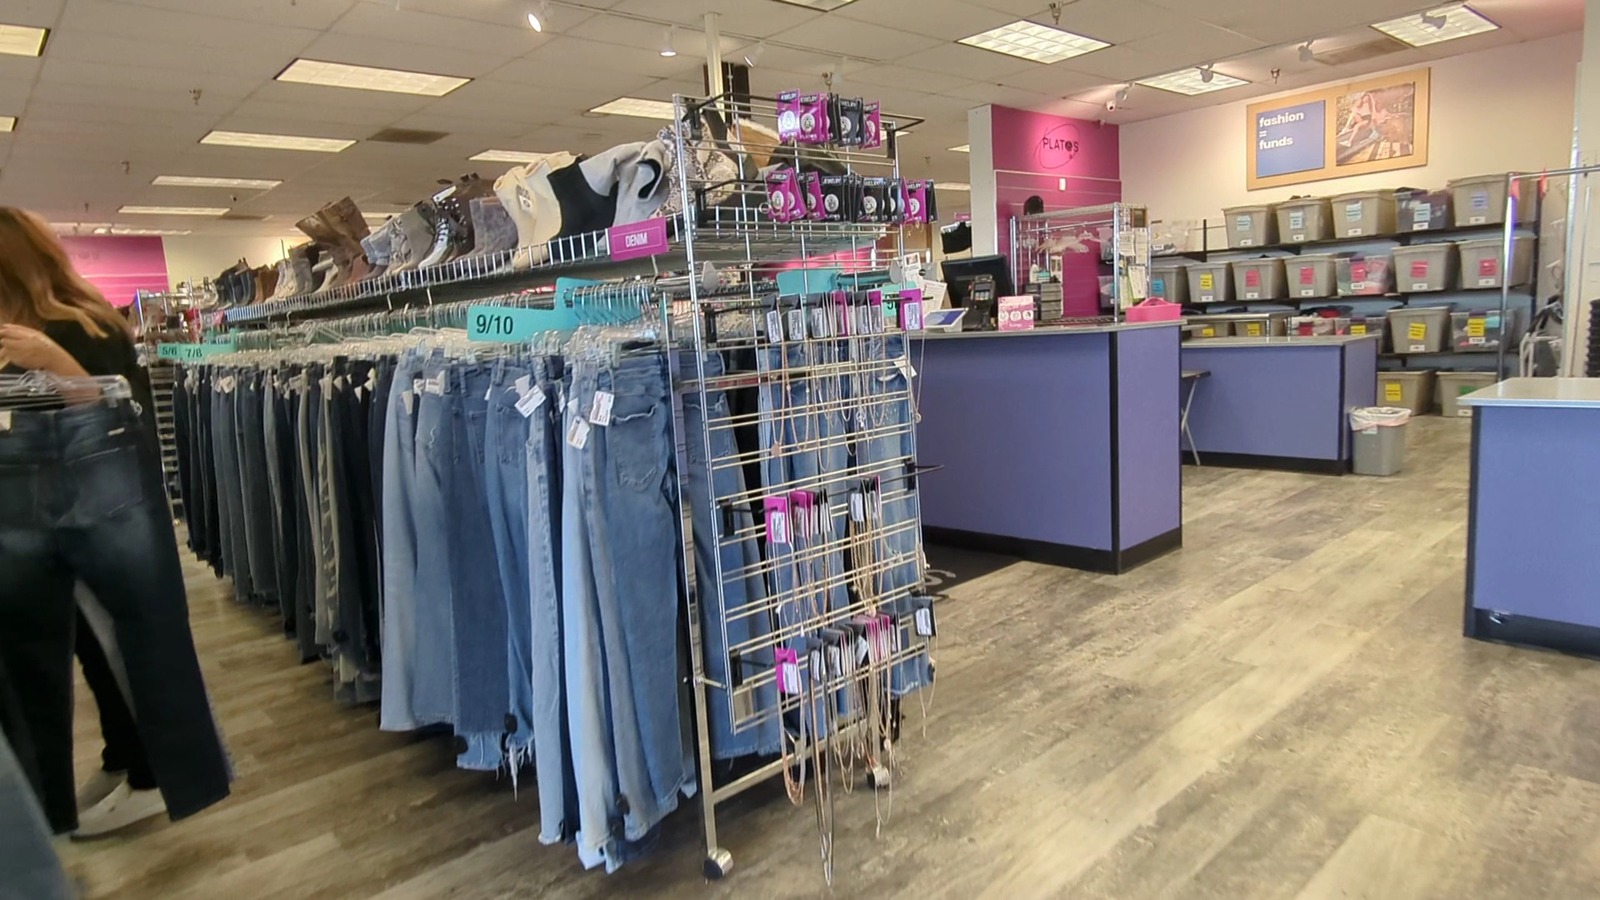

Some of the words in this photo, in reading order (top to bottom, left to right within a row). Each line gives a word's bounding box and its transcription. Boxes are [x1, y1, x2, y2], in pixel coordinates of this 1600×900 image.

[1259, 111, 1305, 128] fashion
[1259, 136, 1294, 150] funds
[625, 232, 648, 248] DENIM
[476, 314, 514, 335] 9/10
